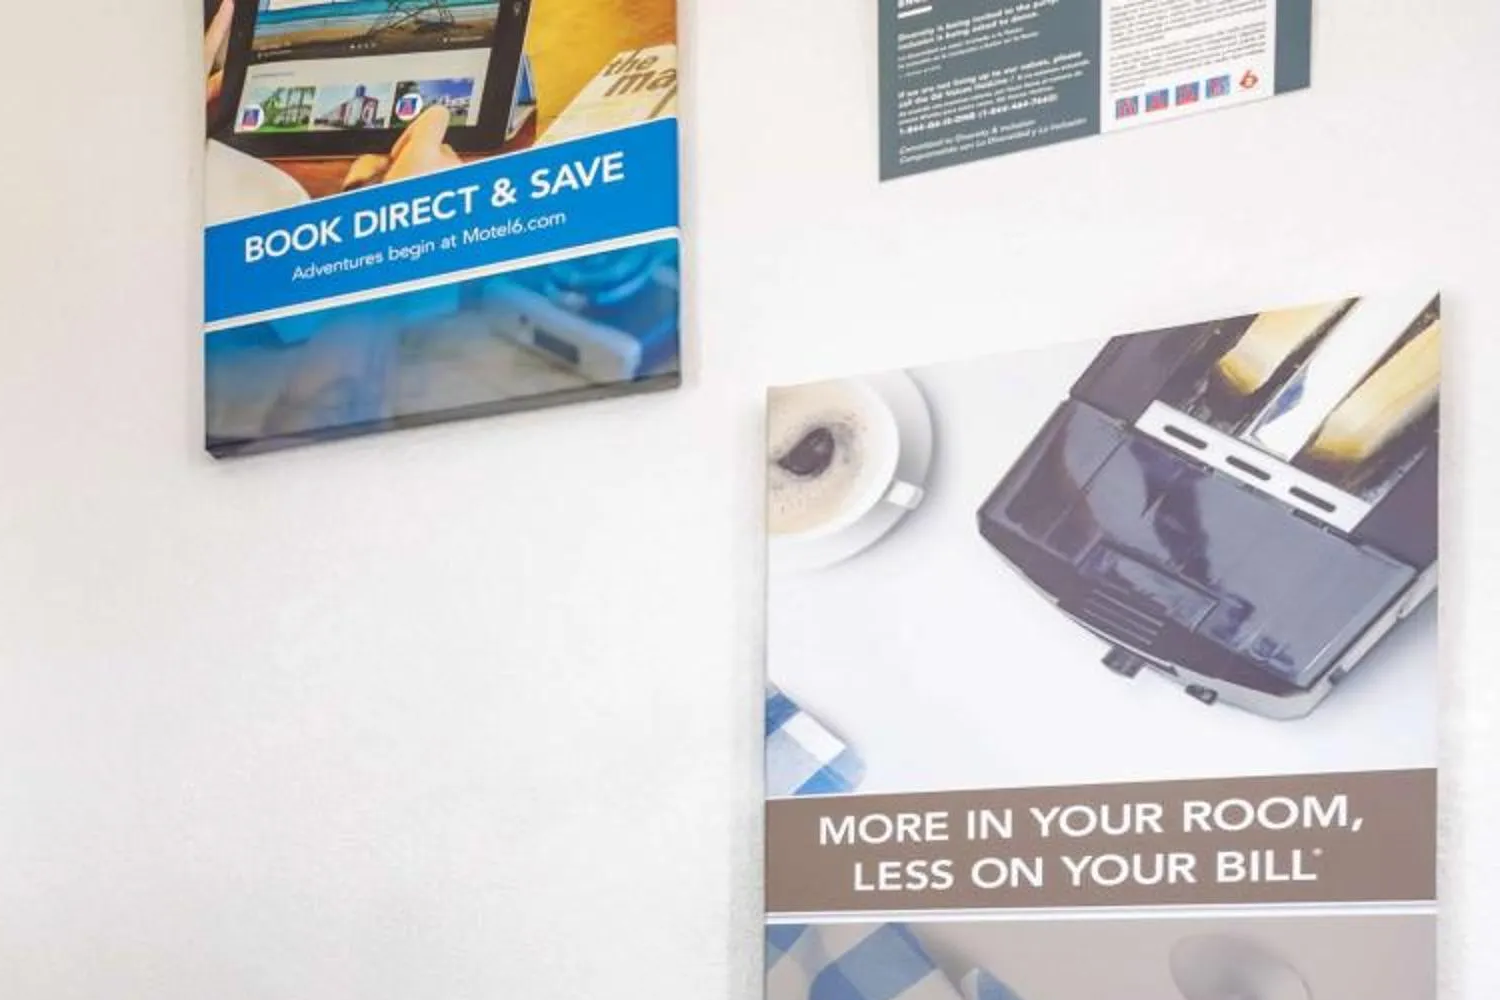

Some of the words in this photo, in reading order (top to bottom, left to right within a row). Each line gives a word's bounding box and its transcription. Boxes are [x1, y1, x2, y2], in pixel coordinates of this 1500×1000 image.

[603, 48, 658, 76] the
[244, 216, 343, 263] BOOK
[353, 186, 479, 237] DIRECT
[490, 177, 518, 208] &
[530, 151, 625, 200] SAVE
[291, 250, 384, 282] Adventures
[387, 237, 436, 264] begin
[440, 233, 458, 251] at
[462, 210, 567, 246] Motel6.com
[818, 810, 949, 846] MORE
[966, 809, 1014, 840] IN
[1030, 802, 1163, 838] YOUR
[1182, 794, 1364, 834] ROOM,
[853, 858, 954, 892] LESS
[970, 855, 1044, 889] ON
[1061, 851, 1198, 887] YOUR
